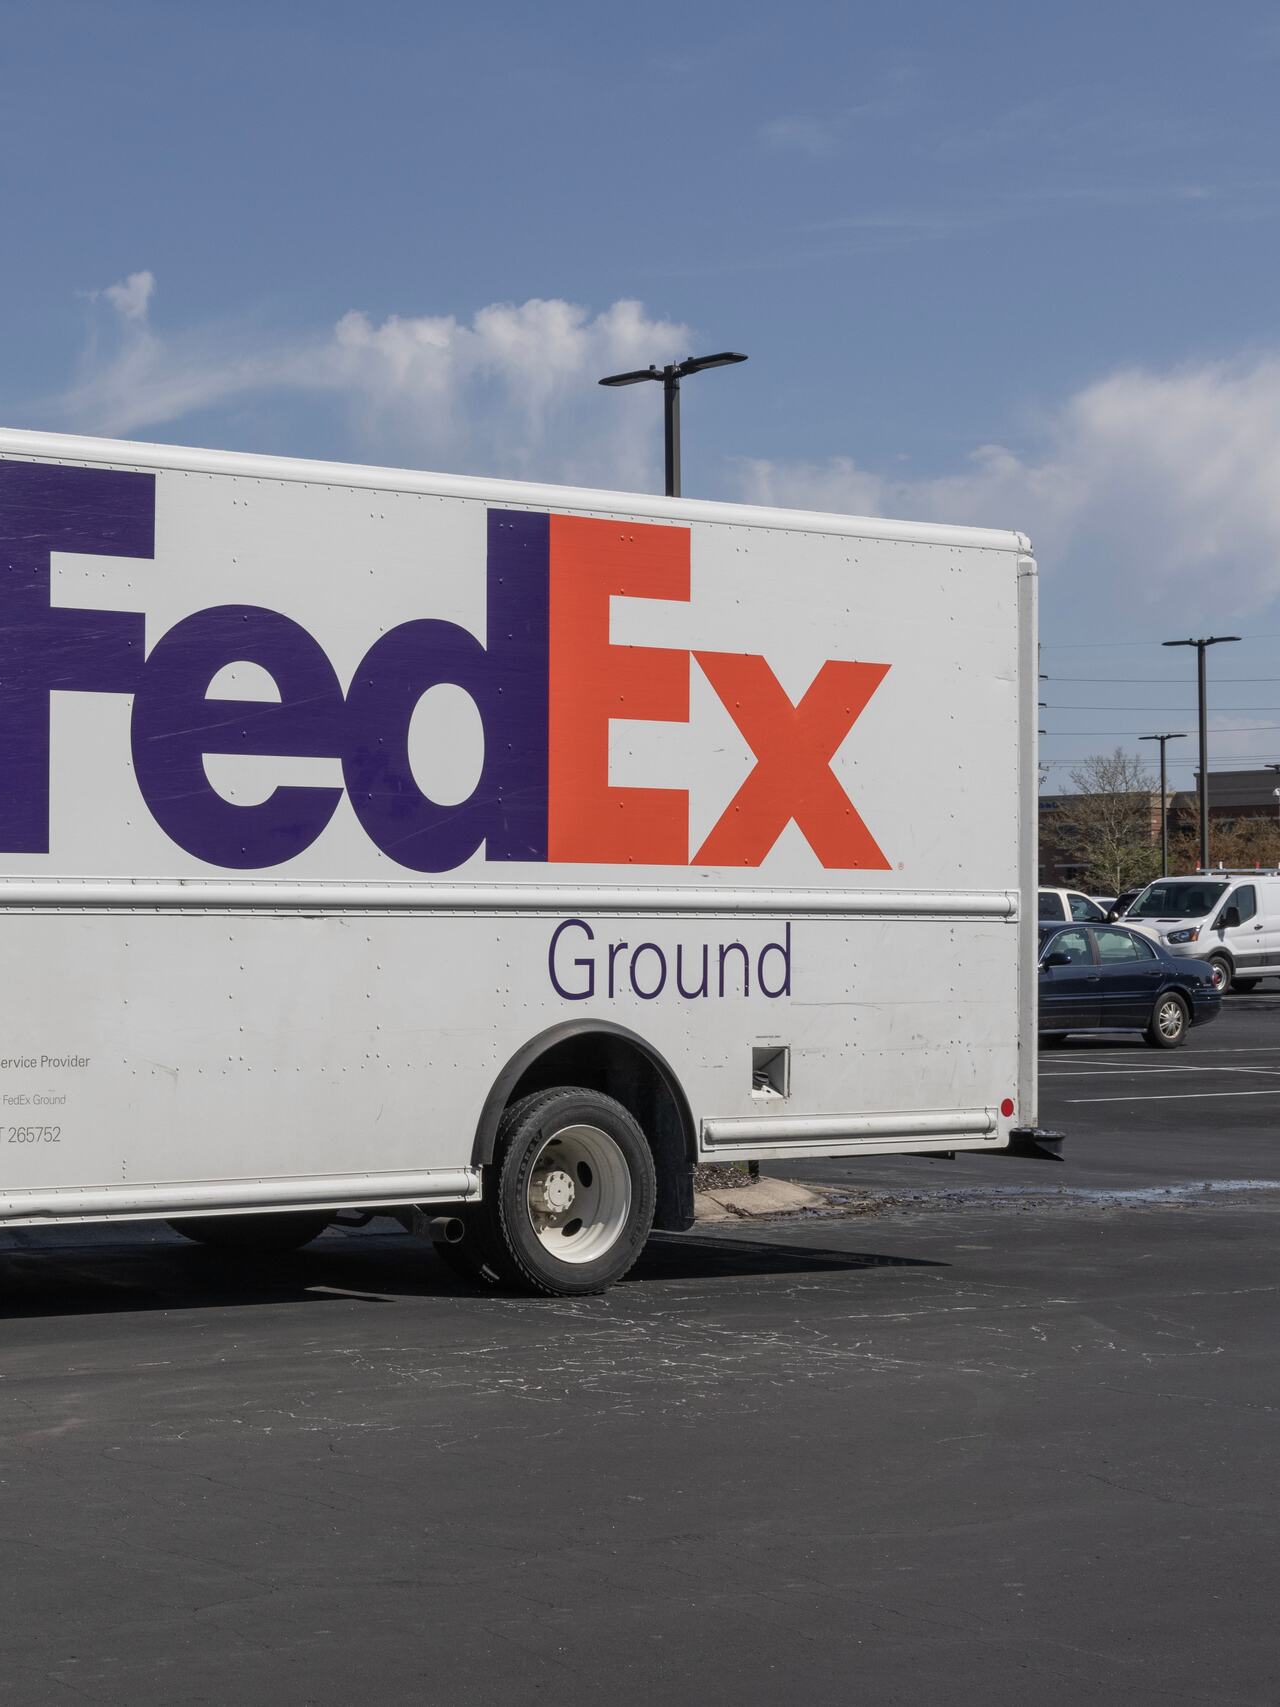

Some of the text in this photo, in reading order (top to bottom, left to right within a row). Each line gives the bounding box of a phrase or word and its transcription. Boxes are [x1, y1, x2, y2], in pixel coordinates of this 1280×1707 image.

[547, 917, 792, 1001] Ground
[40, 1054, 91, 1069] Provider
[2, 1094, 31, 1106] FedEx
[32, 1094, 67, 1106] Ground
[7, 1125, 62, 1144] 265752
